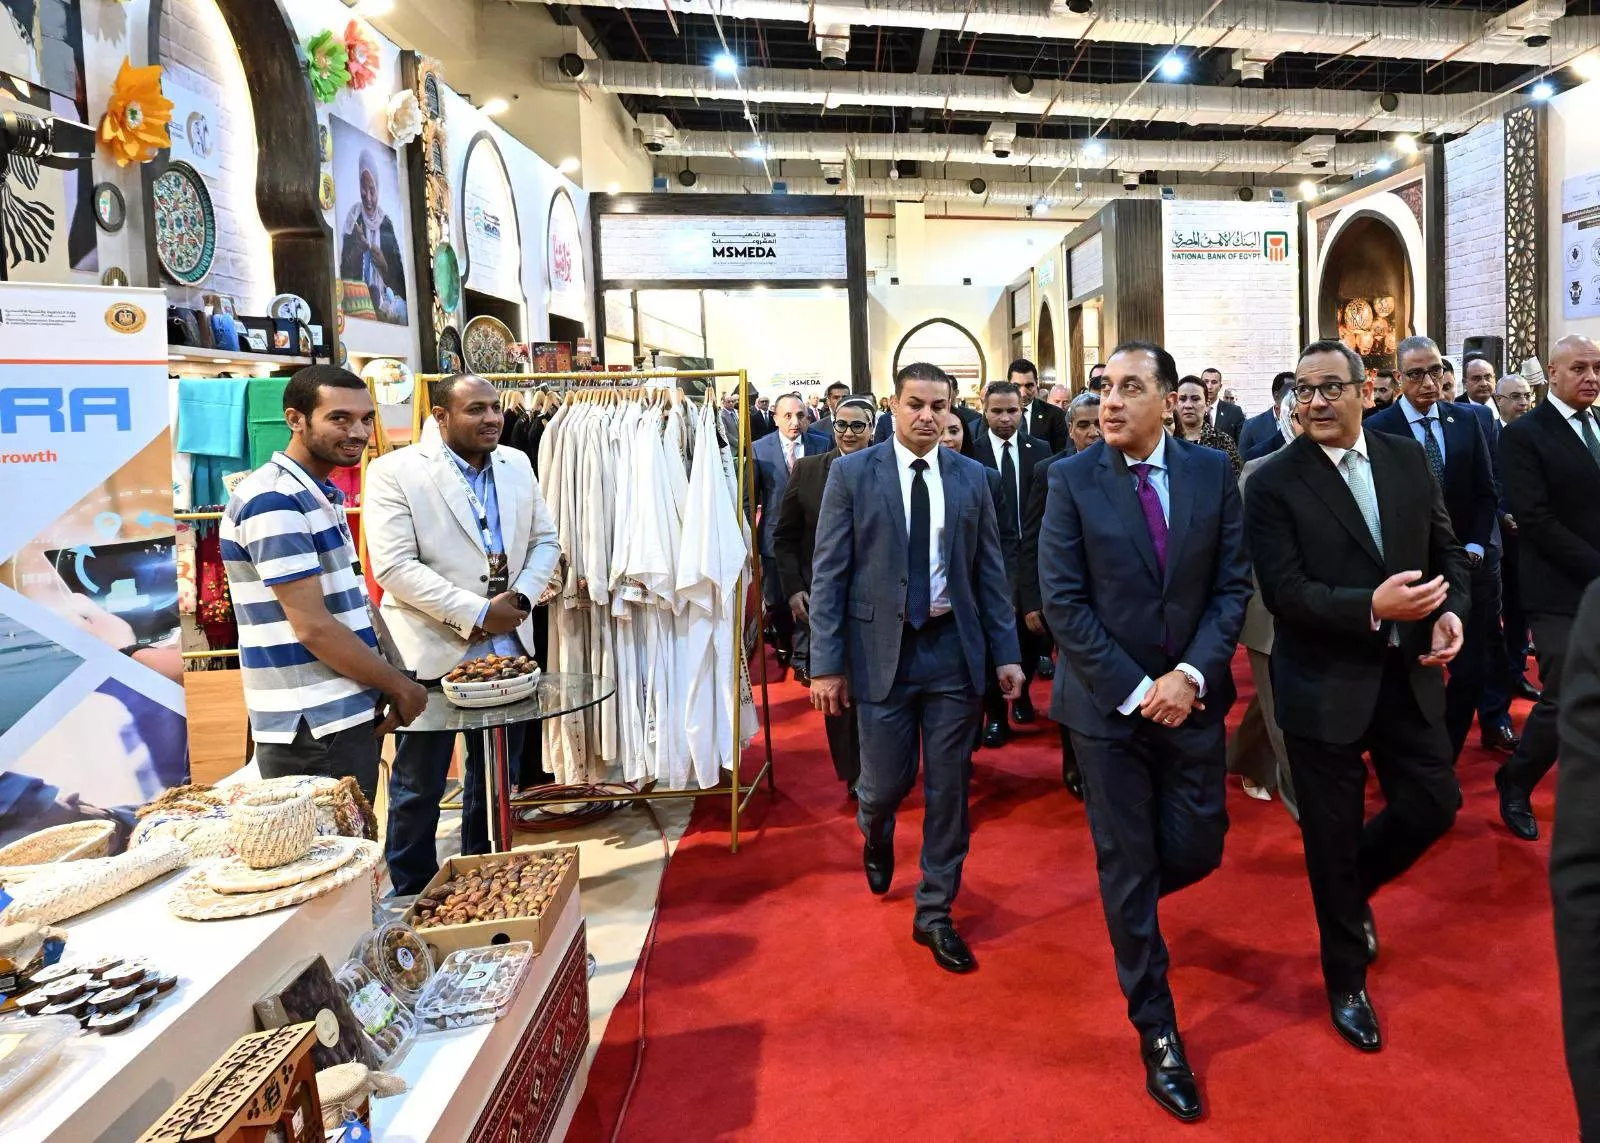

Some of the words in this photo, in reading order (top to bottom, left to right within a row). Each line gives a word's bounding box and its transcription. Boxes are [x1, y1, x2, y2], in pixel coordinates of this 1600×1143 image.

[712, 246, 777, 258] MSMEDA
[0, 387, 131, 434] RA
[0, 450, 57, 464] rowth
